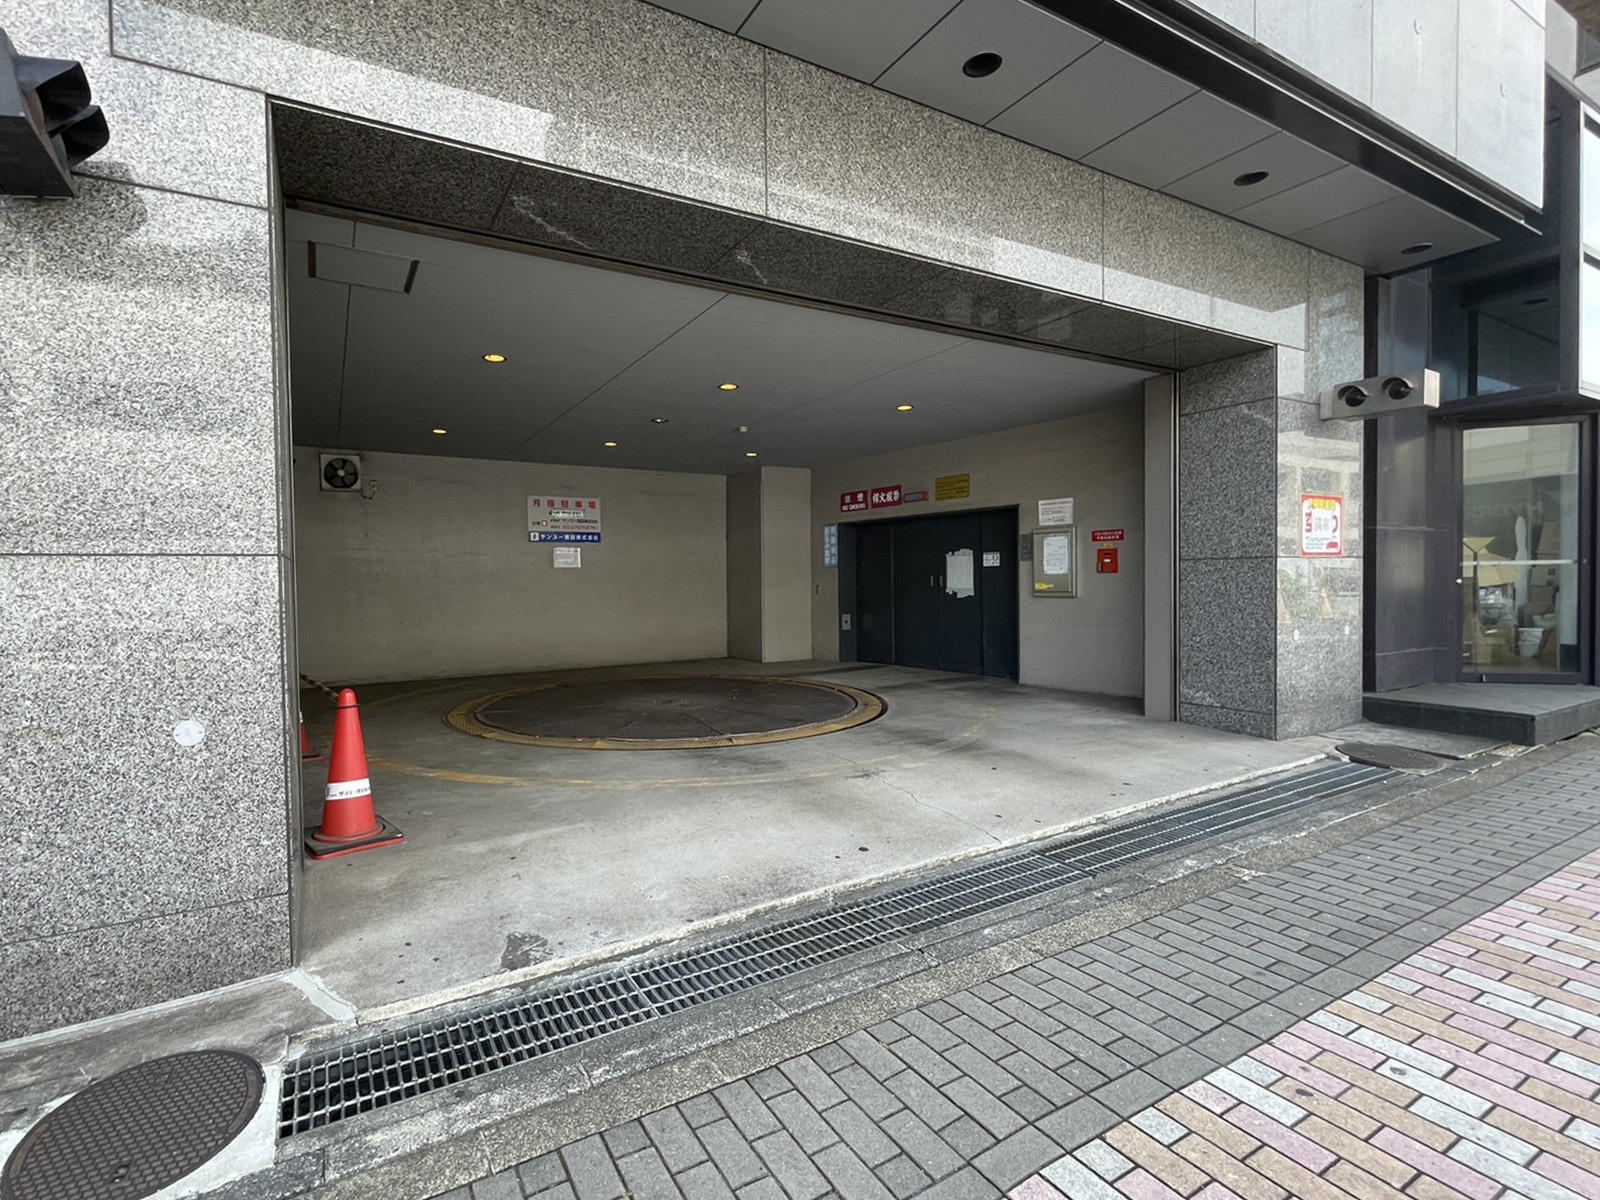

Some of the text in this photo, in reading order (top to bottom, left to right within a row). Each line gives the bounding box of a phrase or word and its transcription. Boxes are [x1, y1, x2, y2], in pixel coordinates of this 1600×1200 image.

[533, 498, 596, 509] 月極駐車場
[849, 502, 867, 511] SMOKING
